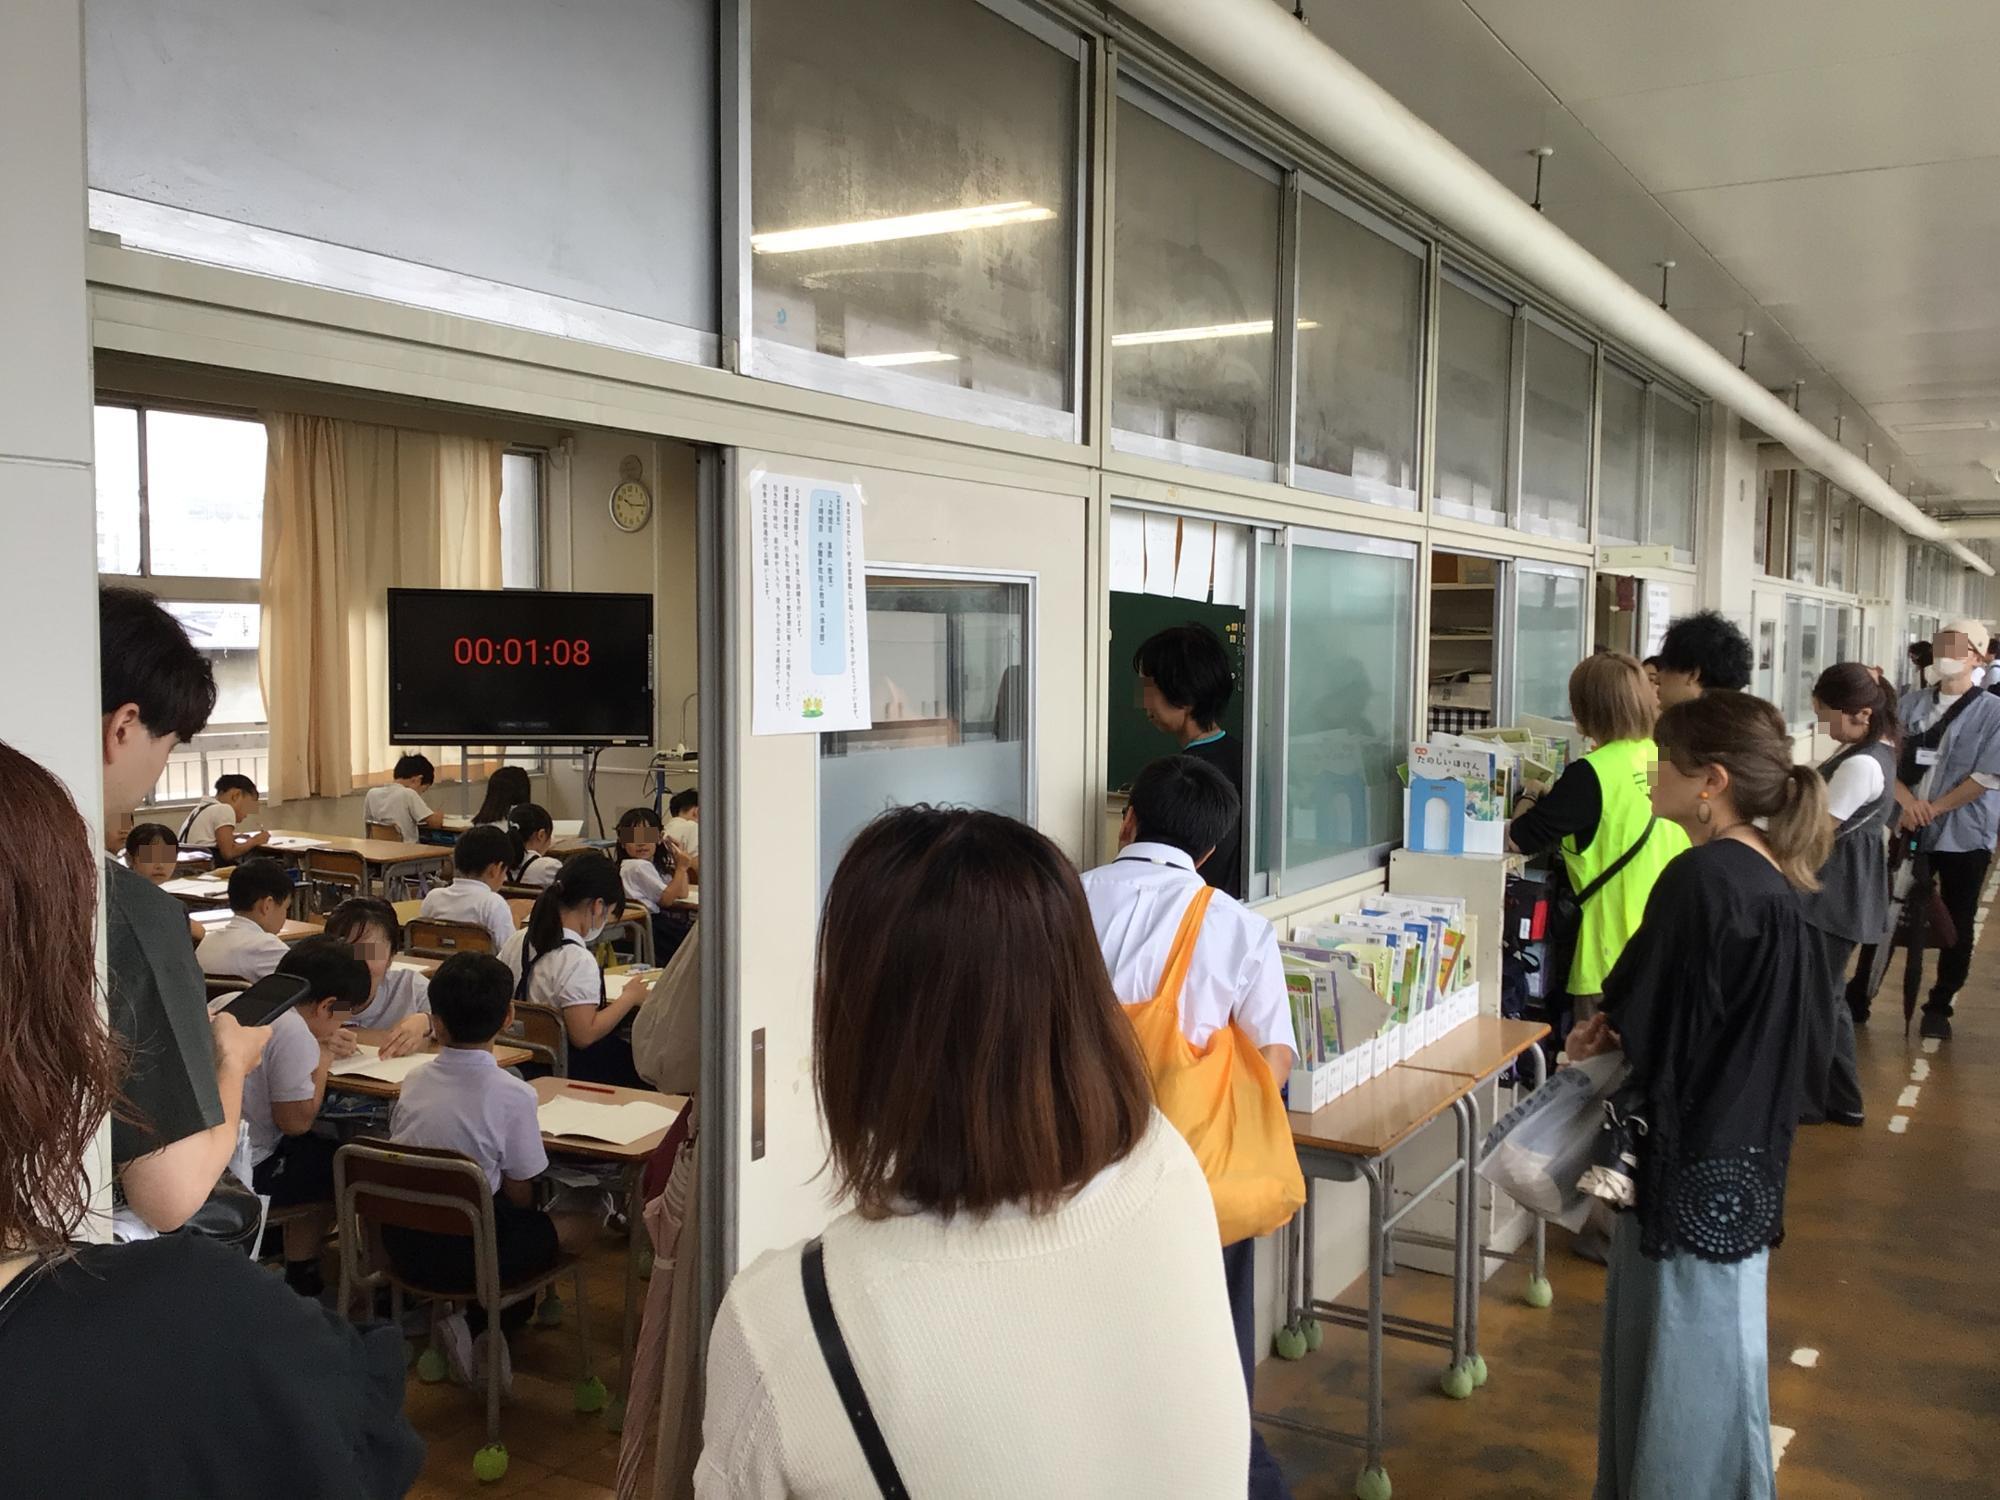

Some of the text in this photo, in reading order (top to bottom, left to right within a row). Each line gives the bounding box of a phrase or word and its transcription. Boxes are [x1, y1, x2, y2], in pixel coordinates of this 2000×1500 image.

[454, 637, 591, 666] 00:01:08
[1416, 755, 1480, 771] たのしいほけん
